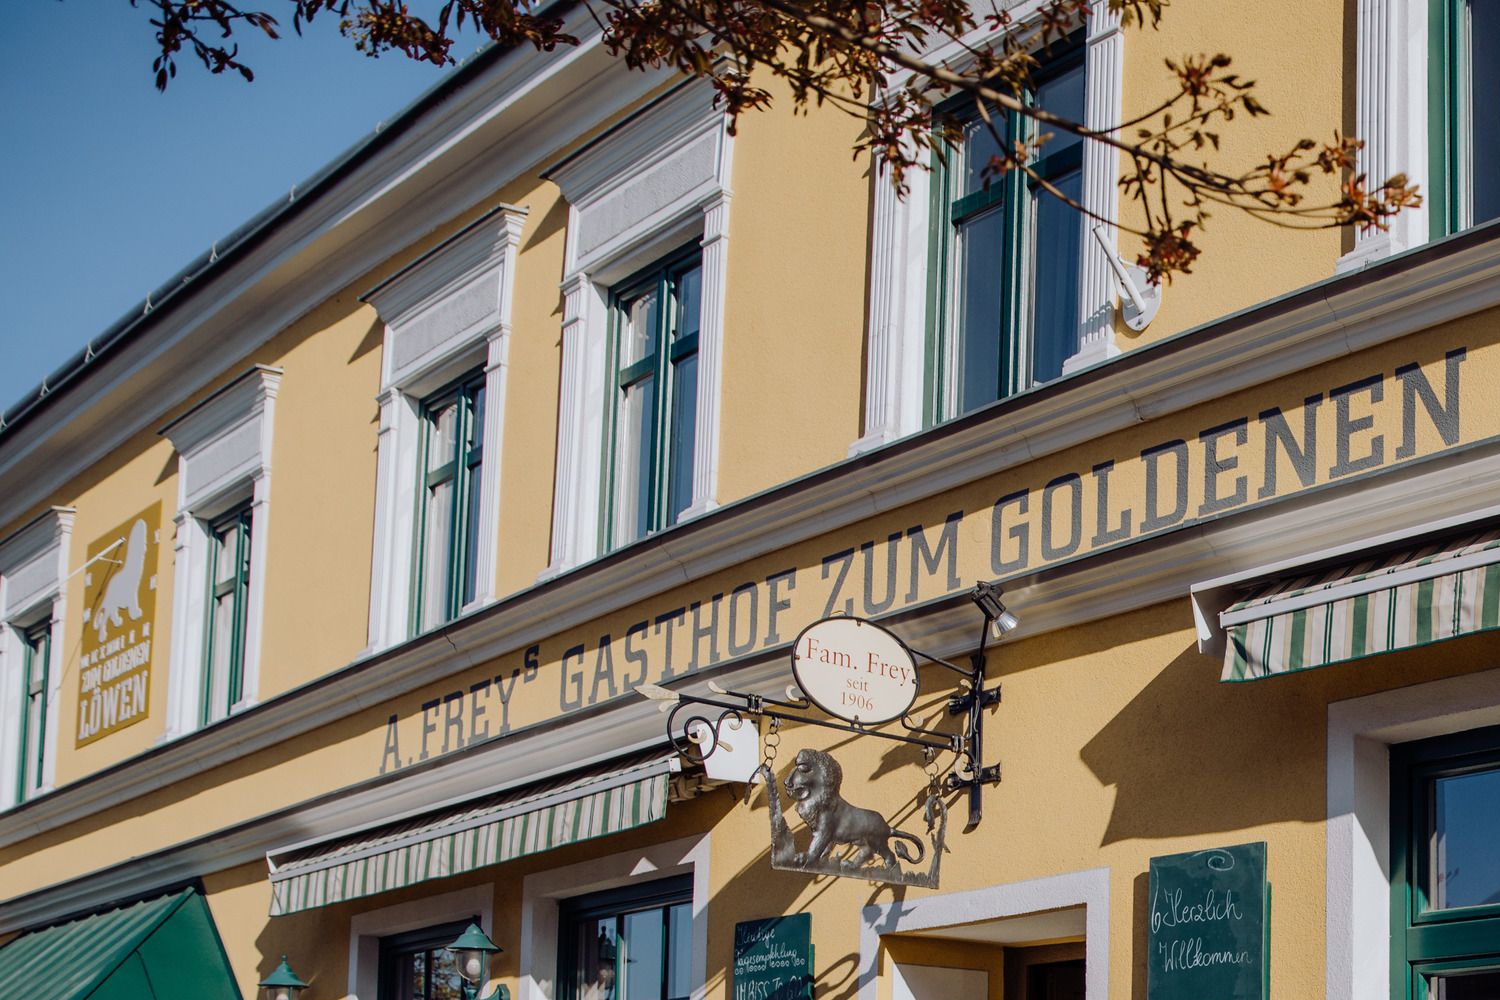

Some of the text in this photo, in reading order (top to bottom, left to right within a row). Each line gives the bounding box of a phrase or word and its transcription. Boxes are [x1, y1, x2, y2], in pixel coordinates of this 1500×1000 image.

[560, 566, 797, 713] GASTHOF
[820, 509, 964, 619] ZUM
[990, 346, 1467, 576] GOLDENEN
[806, 637, 912, 686] Fam. Frey
[840, 691, 874, 711] 1906
[846, 676, 868, 692] seit
[78, 670, 148, 740] LÖWEN
[1162, 887, 1243, 927] Herzlich
[1158, 936, 1253, 973] Willkommen
